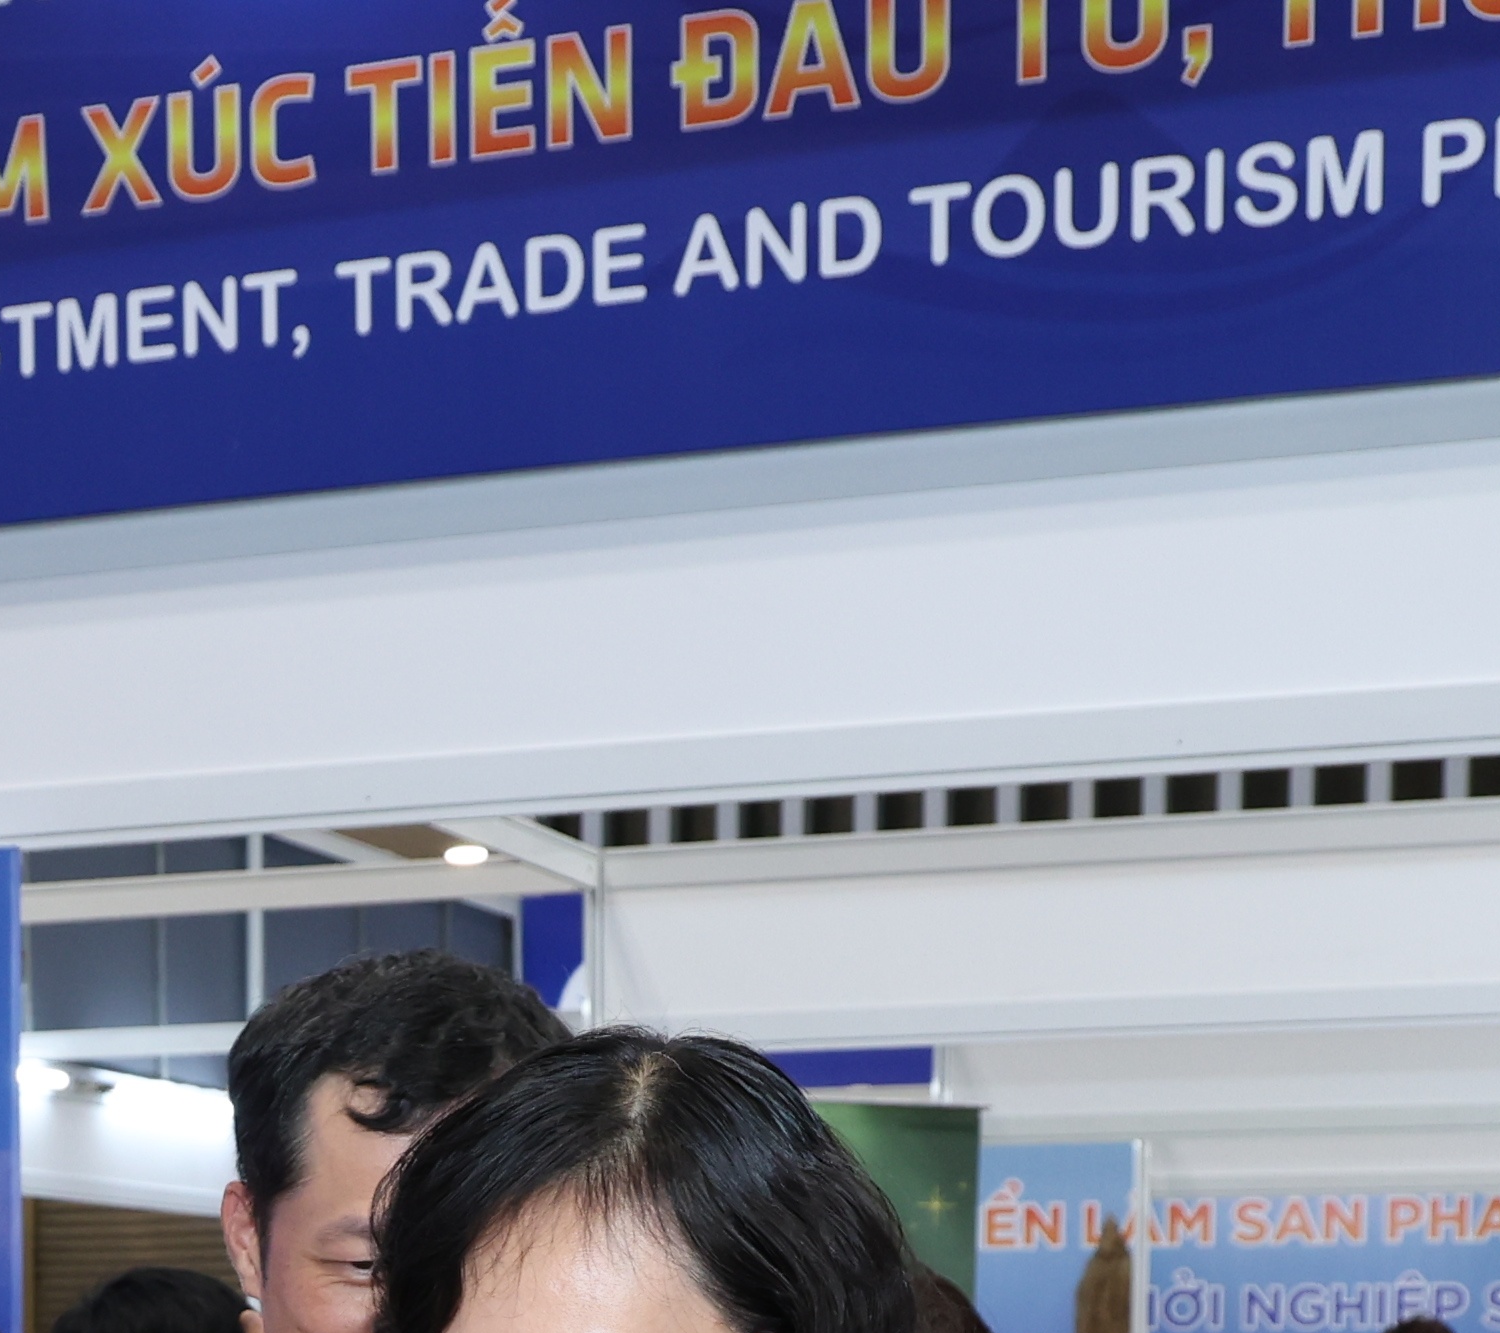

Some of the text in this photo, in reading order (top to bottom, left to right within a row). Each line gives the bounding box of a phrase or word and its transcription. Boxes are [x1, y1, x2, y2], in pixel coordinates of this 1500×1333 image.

[83, 56, 314, 216] XÚC
[335, 223, 647, 336] TRADE
[673, 196, 881, 298] AND
[910, 129, 1384, 268] TOURISM
